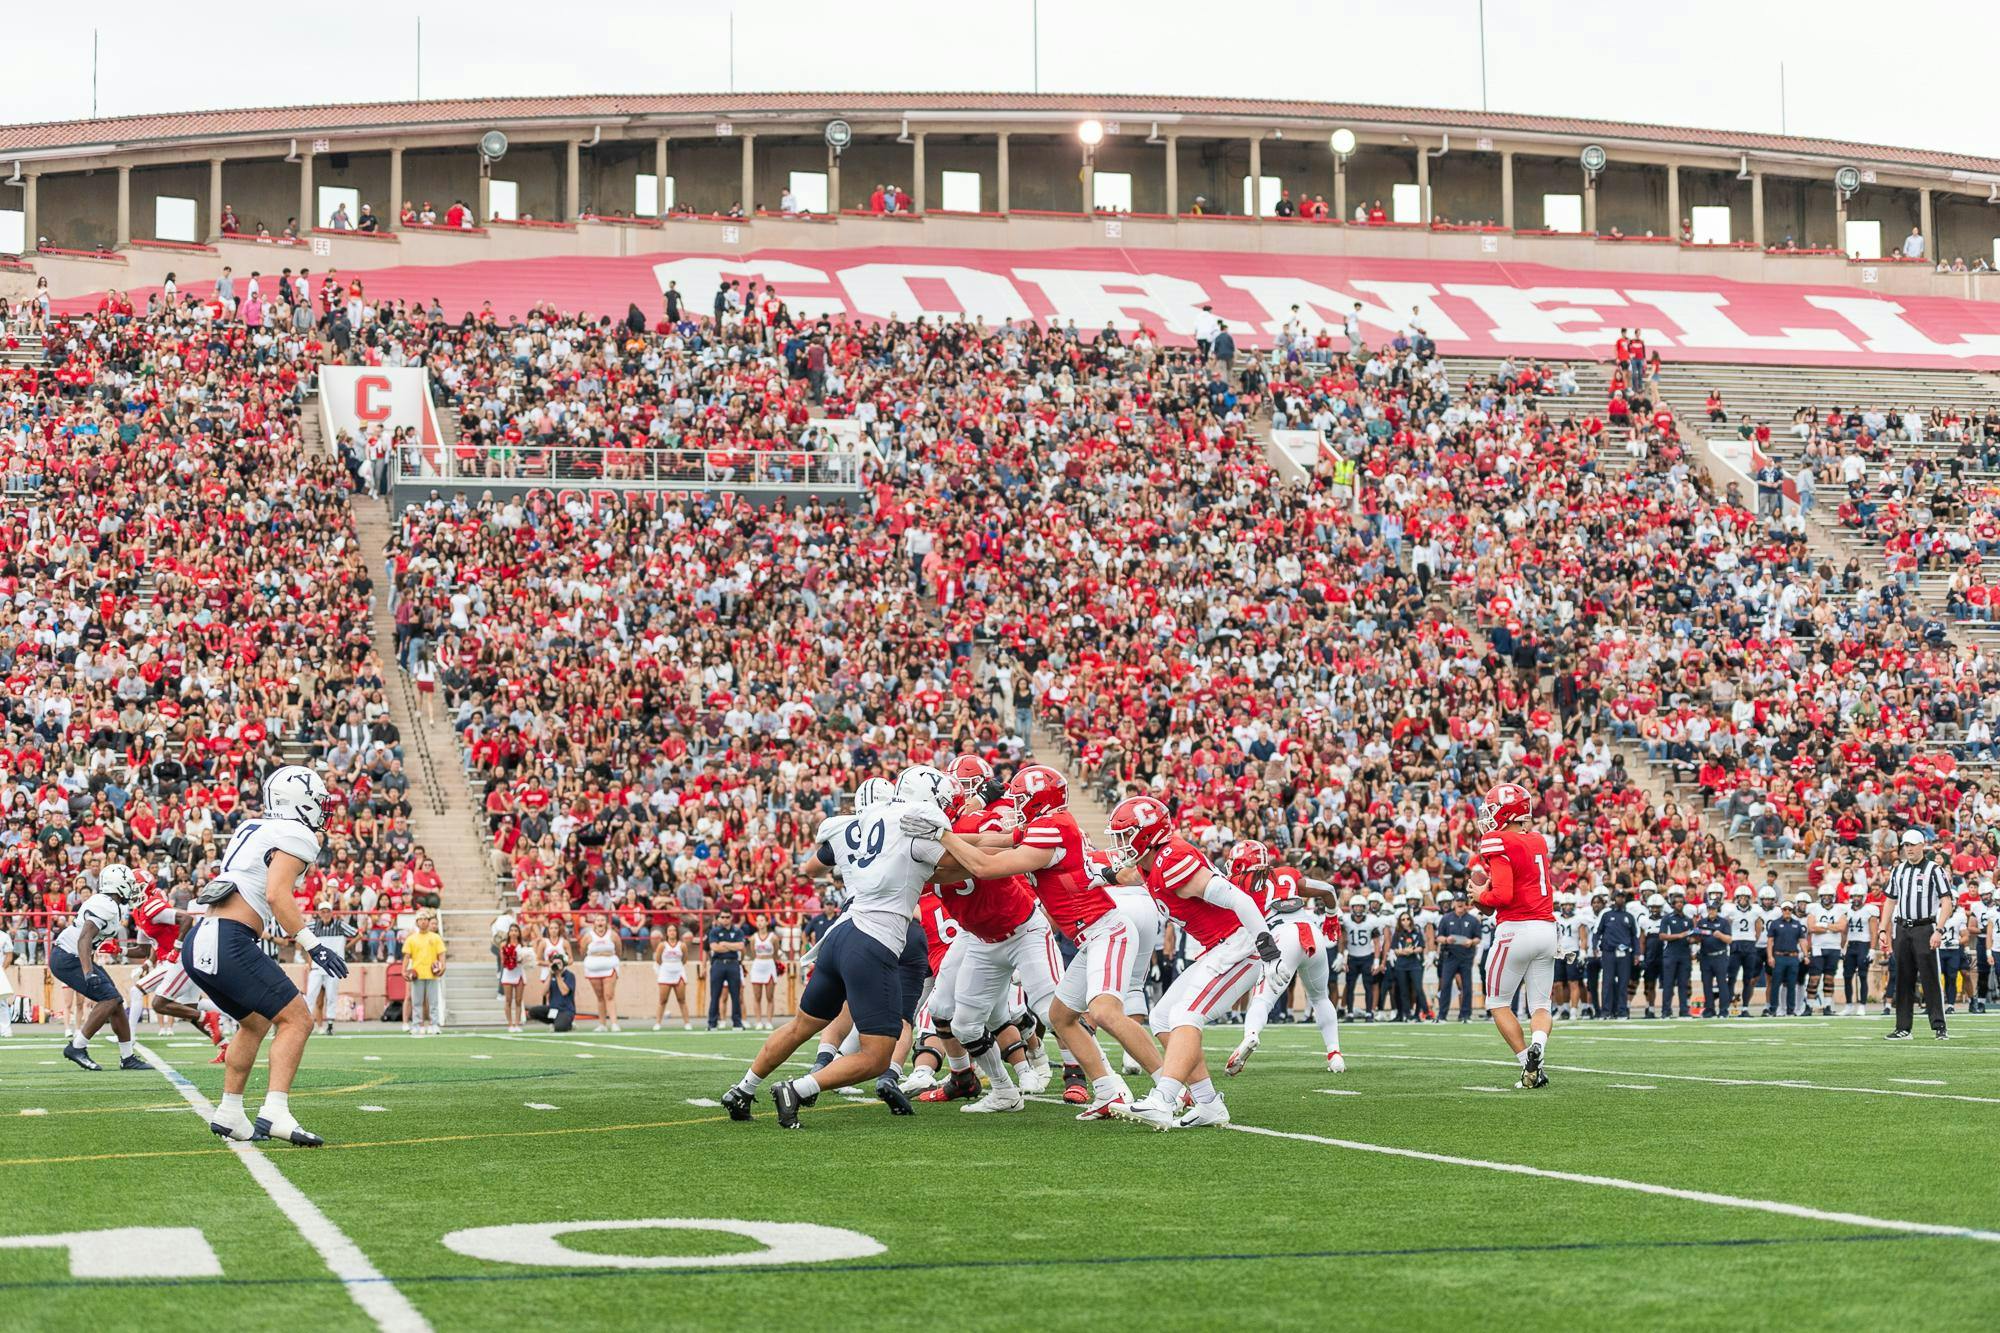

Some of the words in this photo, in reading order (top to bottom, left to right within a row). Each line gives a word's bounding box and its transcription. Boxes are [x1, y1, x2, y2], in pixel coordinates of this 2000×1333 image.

[652, 257, 2000, 358] CORNELL
[354, 374, 392, 422] C
[293, 773, 313, 794] Y
[1024, 771, 1046, 792] C
[1498, 786, 1515, 804] C
[1132, 802, 1159, 827] C
[224, 823, 262, 873] 7
[1534, 854, 1548, 897] 1
[1739, 918, 1749, 932] 2
[1350, 929, 1368, 946] 15
